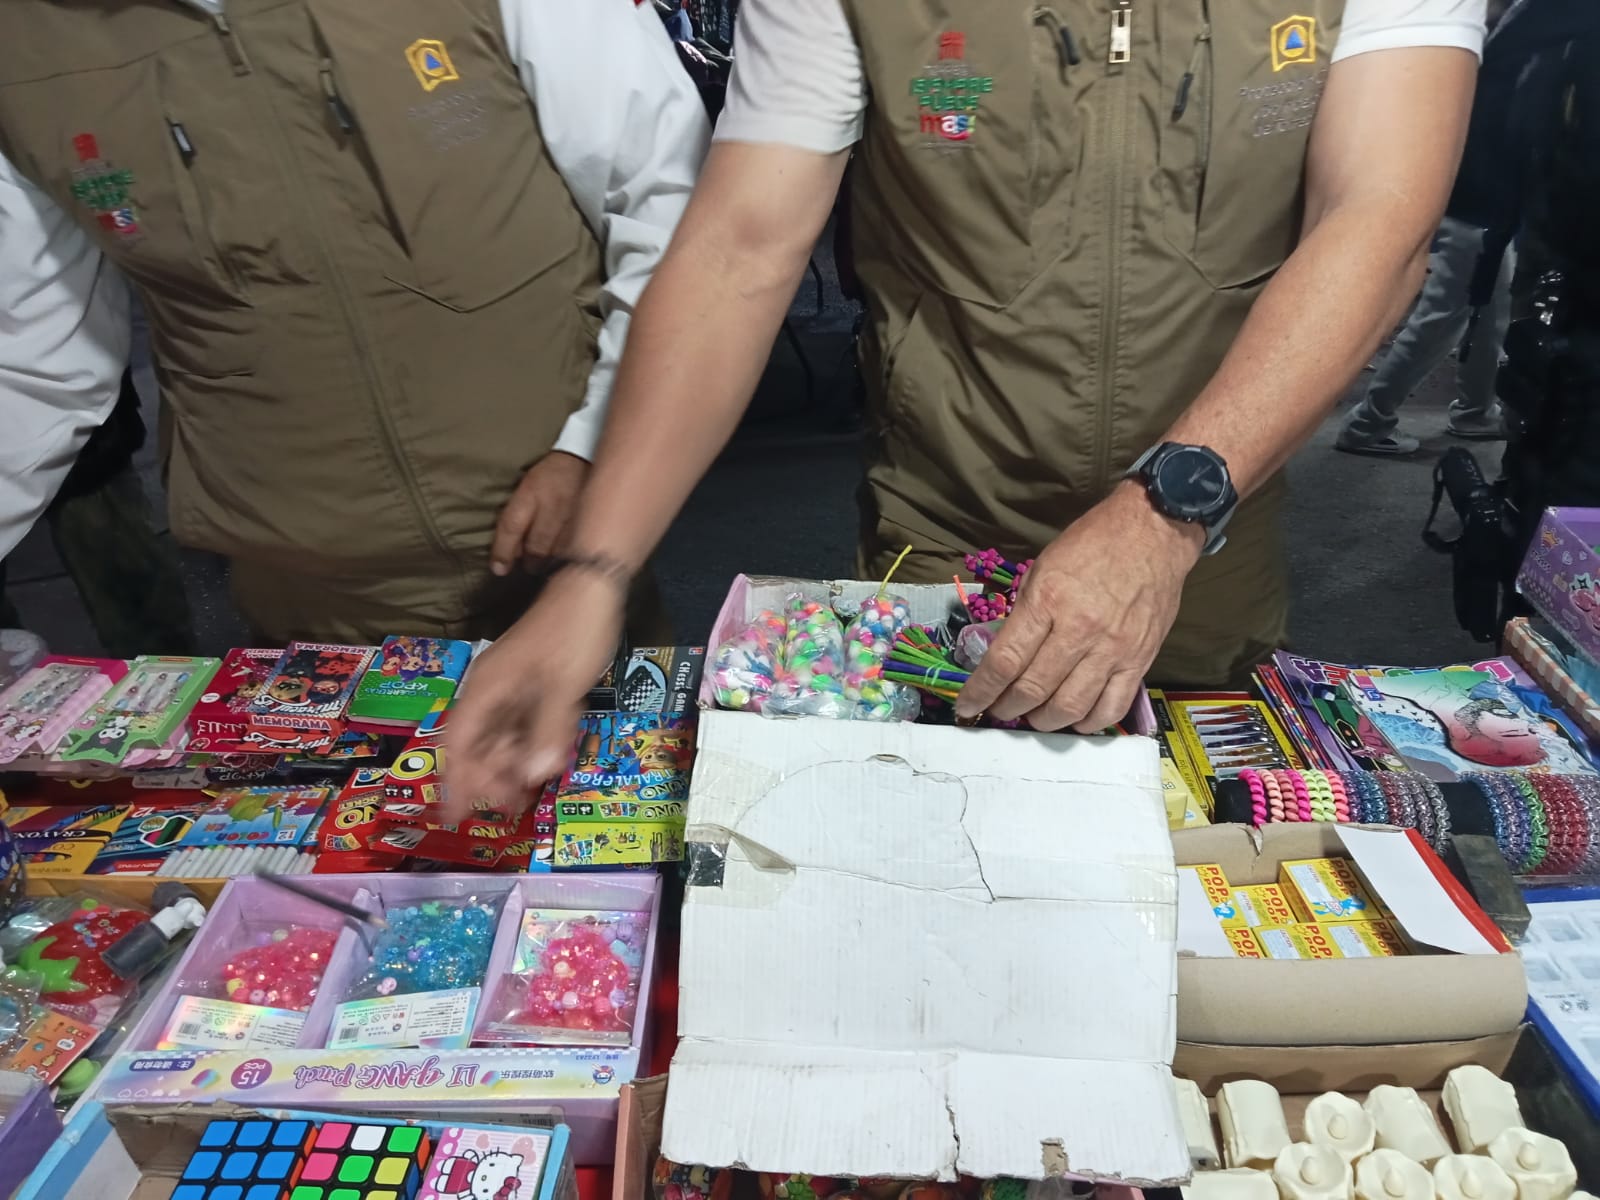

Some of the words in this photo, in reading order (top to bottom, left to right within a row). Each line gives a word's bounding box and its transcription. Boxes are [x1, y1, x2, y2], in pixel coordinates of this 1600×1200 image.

[252, 714, 331, 731] MEMORAMA
[640, 779, 686, 799] UNO
[132, 806, 156, 818] 12
[641, 801, 683, 820] UNO
[13, 830, 87, 839] CRAYON
[277, 831, 294, 841] 12
[1203, 879, 1220, 903] POP
[1206, 867, 1229, 896] POP
[1263, 899, 1280, 924] POP
[1264, 888, 1289, 917] POP
[1304, 937, 1321, 959] PO
[1306, 925, 1333, 956] POP
[242, 1062, 267, 1071] PCS
[447, 1063, 480, 1087] LI
[238, 1070, 261, 1086] 15
